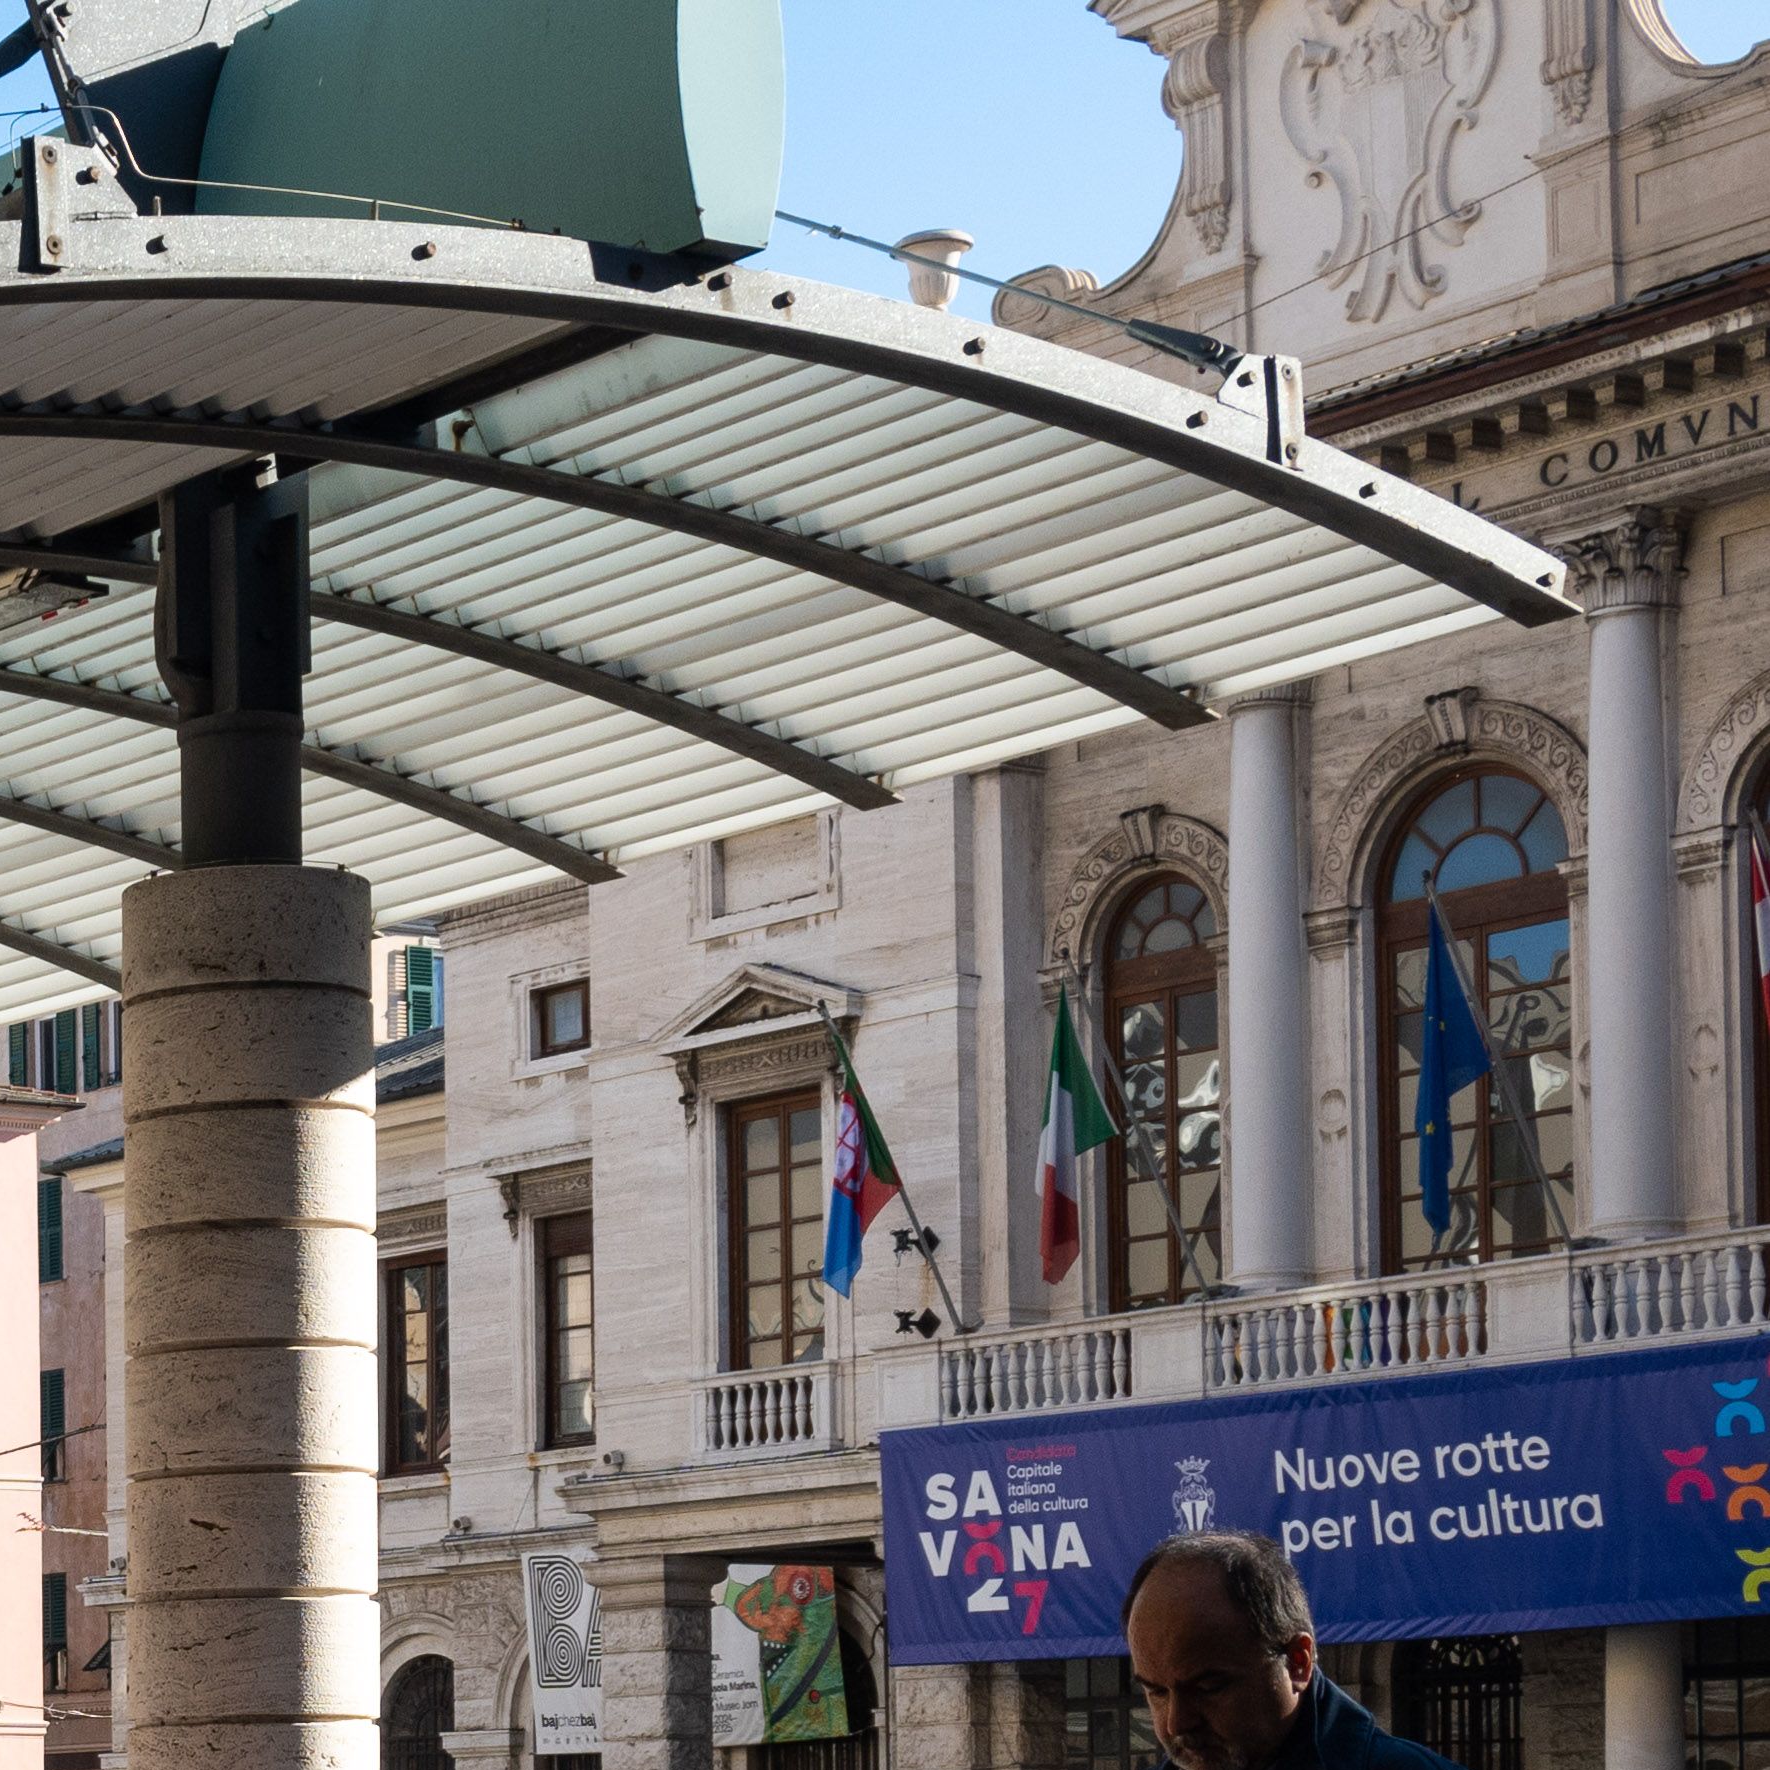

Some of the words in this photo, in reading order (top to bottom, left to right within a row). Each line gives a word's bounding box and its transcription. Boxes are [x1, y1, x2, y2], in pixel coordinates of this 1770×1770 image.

[1540, 395, 1760, 487] COMVN
[1006, 1461, 1062, 1480] Capitale
[1274, 1443, 1421, 1494] Nuove
[1435, 1430, 1551, 1479] rotte
[925, 1470, 1002, 1520] SA
[1007, 1482, 1056, 1497] italiana
[1008, 1499, 1040, 1514] della
[1042, 1496, 1088, 1512] cultura
[1282, 1512, 1356, 1560] per
[1372, 1499, 1414, 1544] la
[1429, 1487, 1604, 1541] cultura
